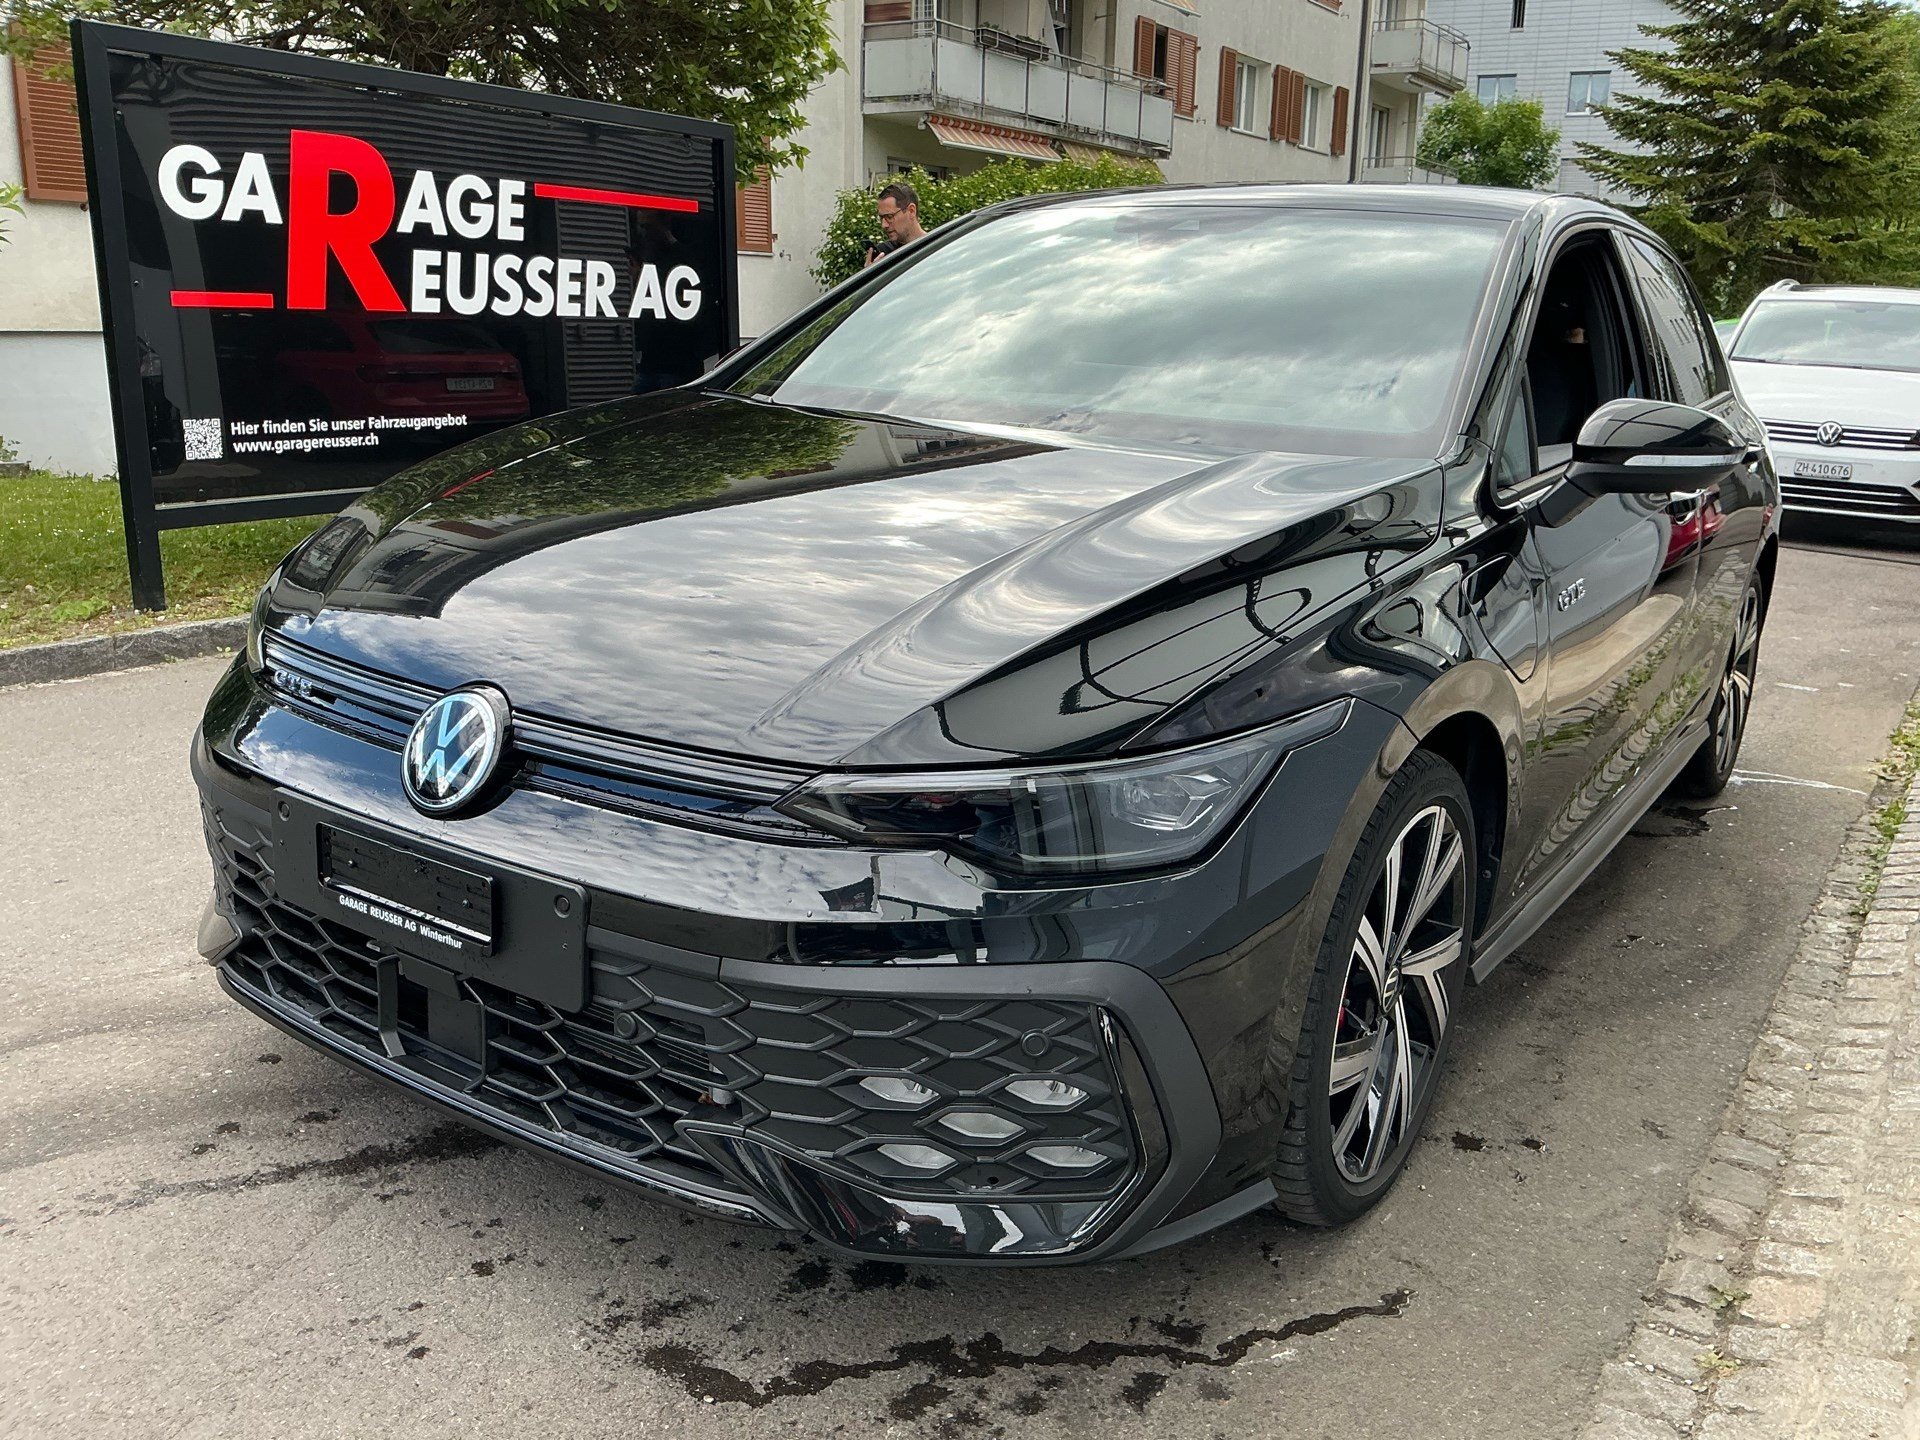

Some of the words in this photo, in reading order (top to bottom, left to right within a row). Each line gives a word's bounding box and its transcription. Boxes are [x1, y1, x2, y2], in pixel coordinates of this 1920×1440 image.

[157, 129, 526, 311] GARAGE
[627, 264, 701, 320] AG
[230, 421, 260, 435] Hier
[262, 419, 306, 434] finden
[309, 418, 329, 432] Sie
[331, 419, 366, 431] unser
[368, 413, 467, 430] Fahrzeugangebot
[232, 432, 379, 453] www.garagereusser.ch
[1557, 577, 1587, 612] GTE
[274, 669, 312, 697] GTE
[339, 895, 368, 914] GARAGE
[370, 906, 403, 927] REUSSER
[404, 919, 417, 932] AG
[420, 925, 463, 949] Winterthur
